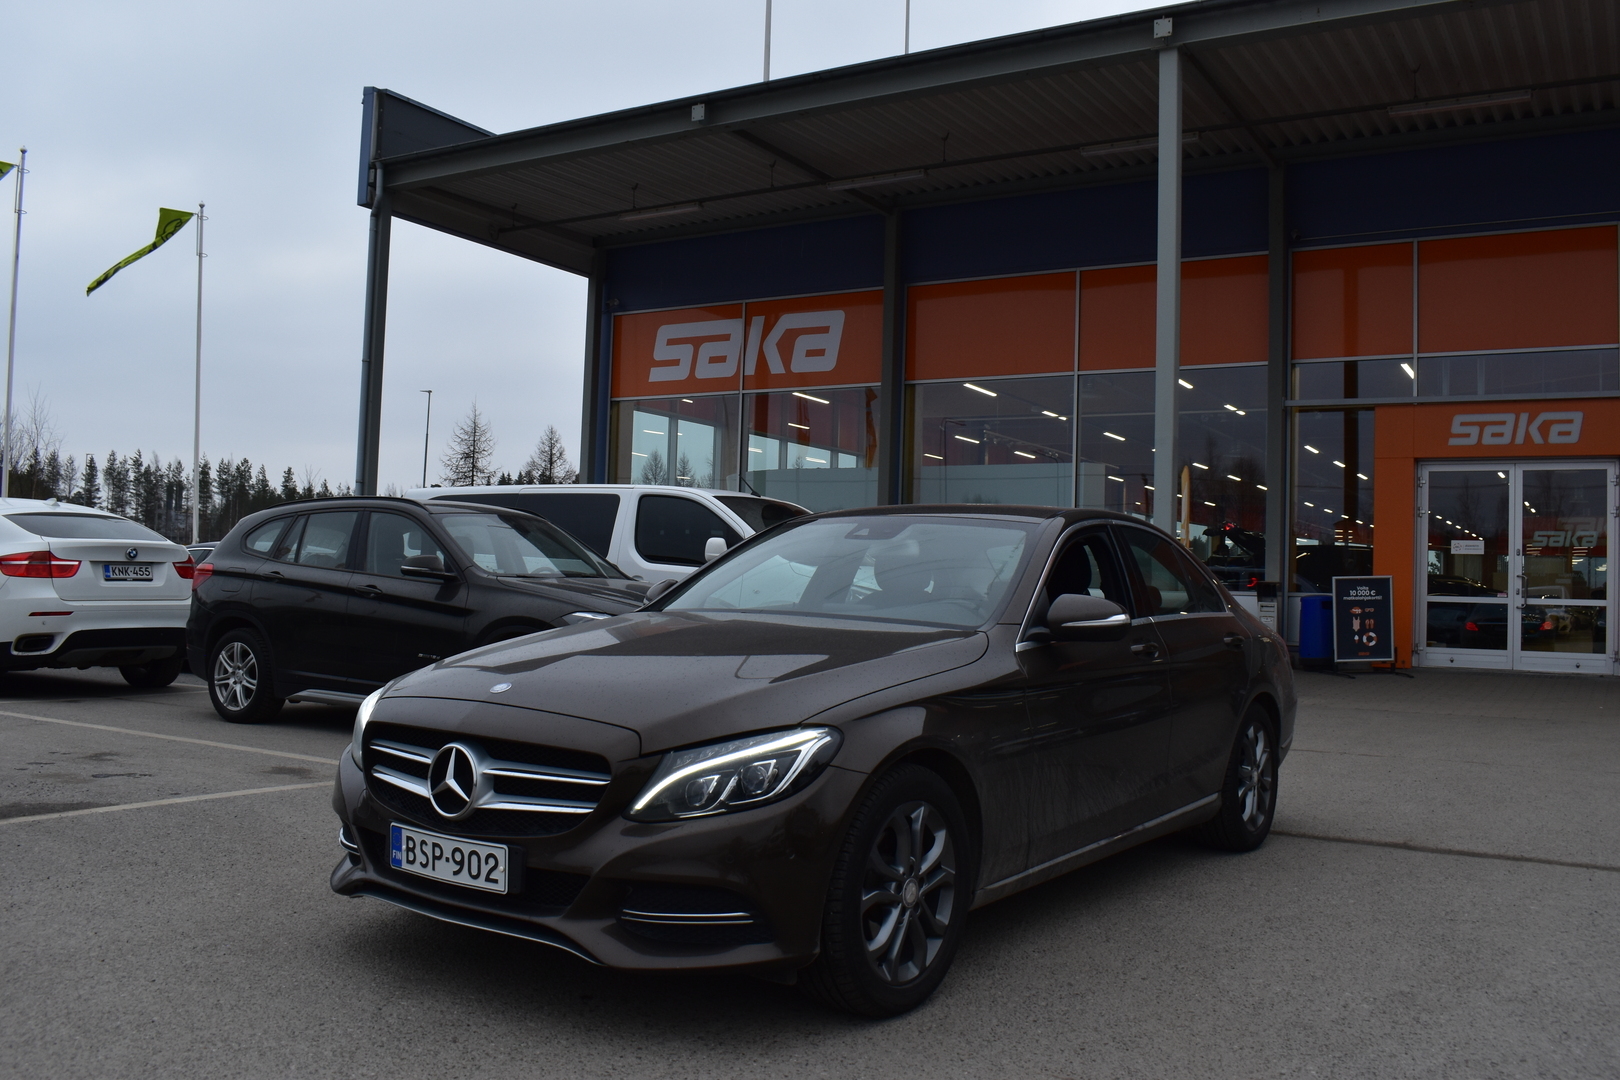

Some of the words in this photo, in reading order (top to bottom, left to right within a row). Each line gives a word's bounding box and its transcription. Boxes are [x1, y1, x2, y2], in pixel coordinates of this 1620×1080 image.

[111, 567, 151, 576] KNK-455
[392, 850, 402, 860] FIN
[406, 835, 499, 884] BSP-902
